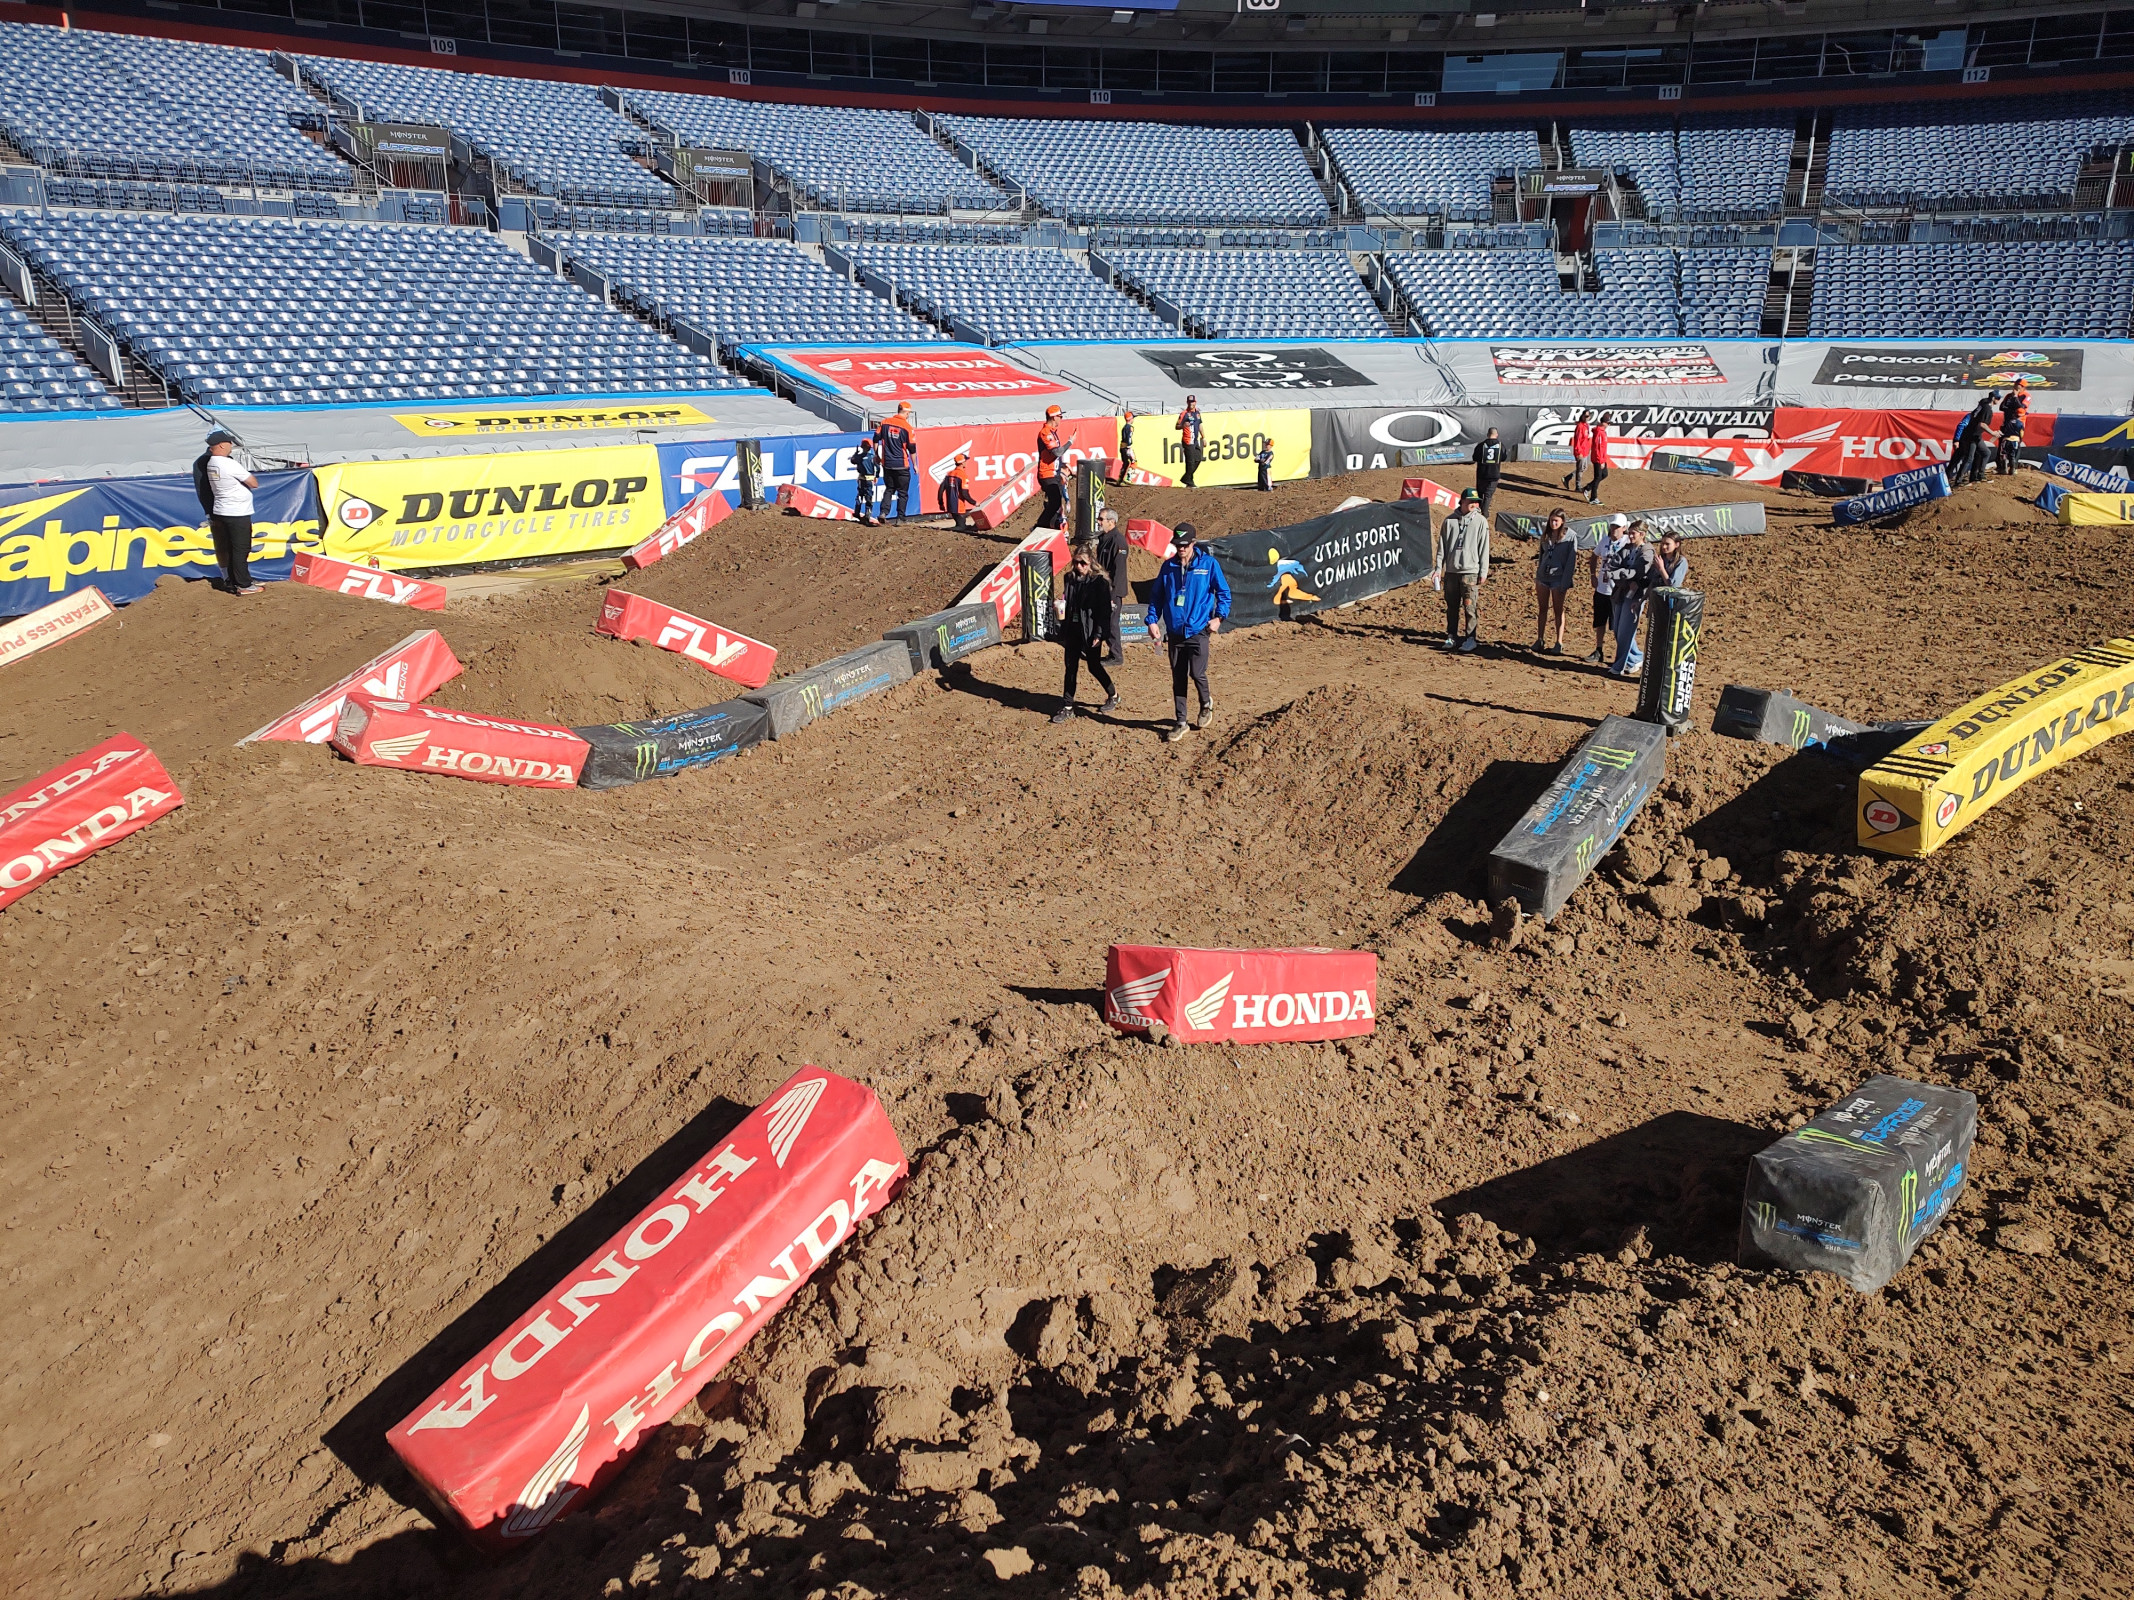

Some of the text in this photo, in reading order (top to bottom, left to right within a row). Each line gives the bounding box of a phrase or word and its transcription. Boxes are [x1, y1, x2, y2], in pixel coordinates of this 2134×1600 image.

[431, 39, 455, 53] 109
[730, 70, 749, 83] 110
[1966, 69, 1987, 81] 112
[1092, 90, 1110, 102] 110
[1417, 92, 1434, 105] 111
[1661, 87, 1680, 98] 111
[858, 359, 1004, 371] HONDA
[1186, 361, 1308, 369] OAKLEY
[1842, 354, 1962, 365] peacock
[902, 379, 1051, 393] HONDA
[1833, 373, 1957, 384] peacock
[474, 410, 681, 427] DUNLOP
[476, 416, 679, 433] MOTORCYCLE TIRES
[1640, 407, 1771, 426] MOUNTAIN
[973, 446, 1109, 481] HODA
[1163, 432, 1266, 465] Inta360
[1487, 449, 1495, 460] 3
[1840, 436, 1953, 461] HON
[999, 472, 1032, 516] FLY
[2071, 465, 2129, 494] YAMAHA
[396, 476, 648, 525] DUNLOP
[1864, 481, 1930, 513] YAMAHA
[389, 508, 632, 548] MOTORCYCLE TIRES
[658, 505, 704, 556] FLY
[1646, 513, 1708, 529] NSTER
[1314, 523, 1400, 563] UTAH SPORTS
[1314, 548, 1402, 588] COMMISSION
[339, 569, 418, 604] FLY
[26, 599, 100, 641] FEARLESS
[657, 615, 747, 667] FLY
[721, 647, 749, 668] RACING
[1640, 612, 1656, 706] WORLD CHAMPIONSHIP
[833, 663, 872, 685] MONSTER
[1675, 660, 1689, 713] SUPER
[1684, 662, 1695, 710] MOTO
[823, 672, 891, 709] SUPERCROSS
[1947, 659, 2084, 741] DUNLOP
[418, 708, 583, 741] HONDA
[333, 733, 357, 754] HONDA
[422, 745, 576, 784] HONDA
[1568, 785, 1608, 826] MONSTER
[0, 786, 173, 894] ONDA
[1231, 990, 1375, 1029] HONDA
[1796, 1213, 1842, 1231] MONSTER
[406, 1143, 757, 1437] HONDA
[603, 1157, 901, 1447] HONDA
